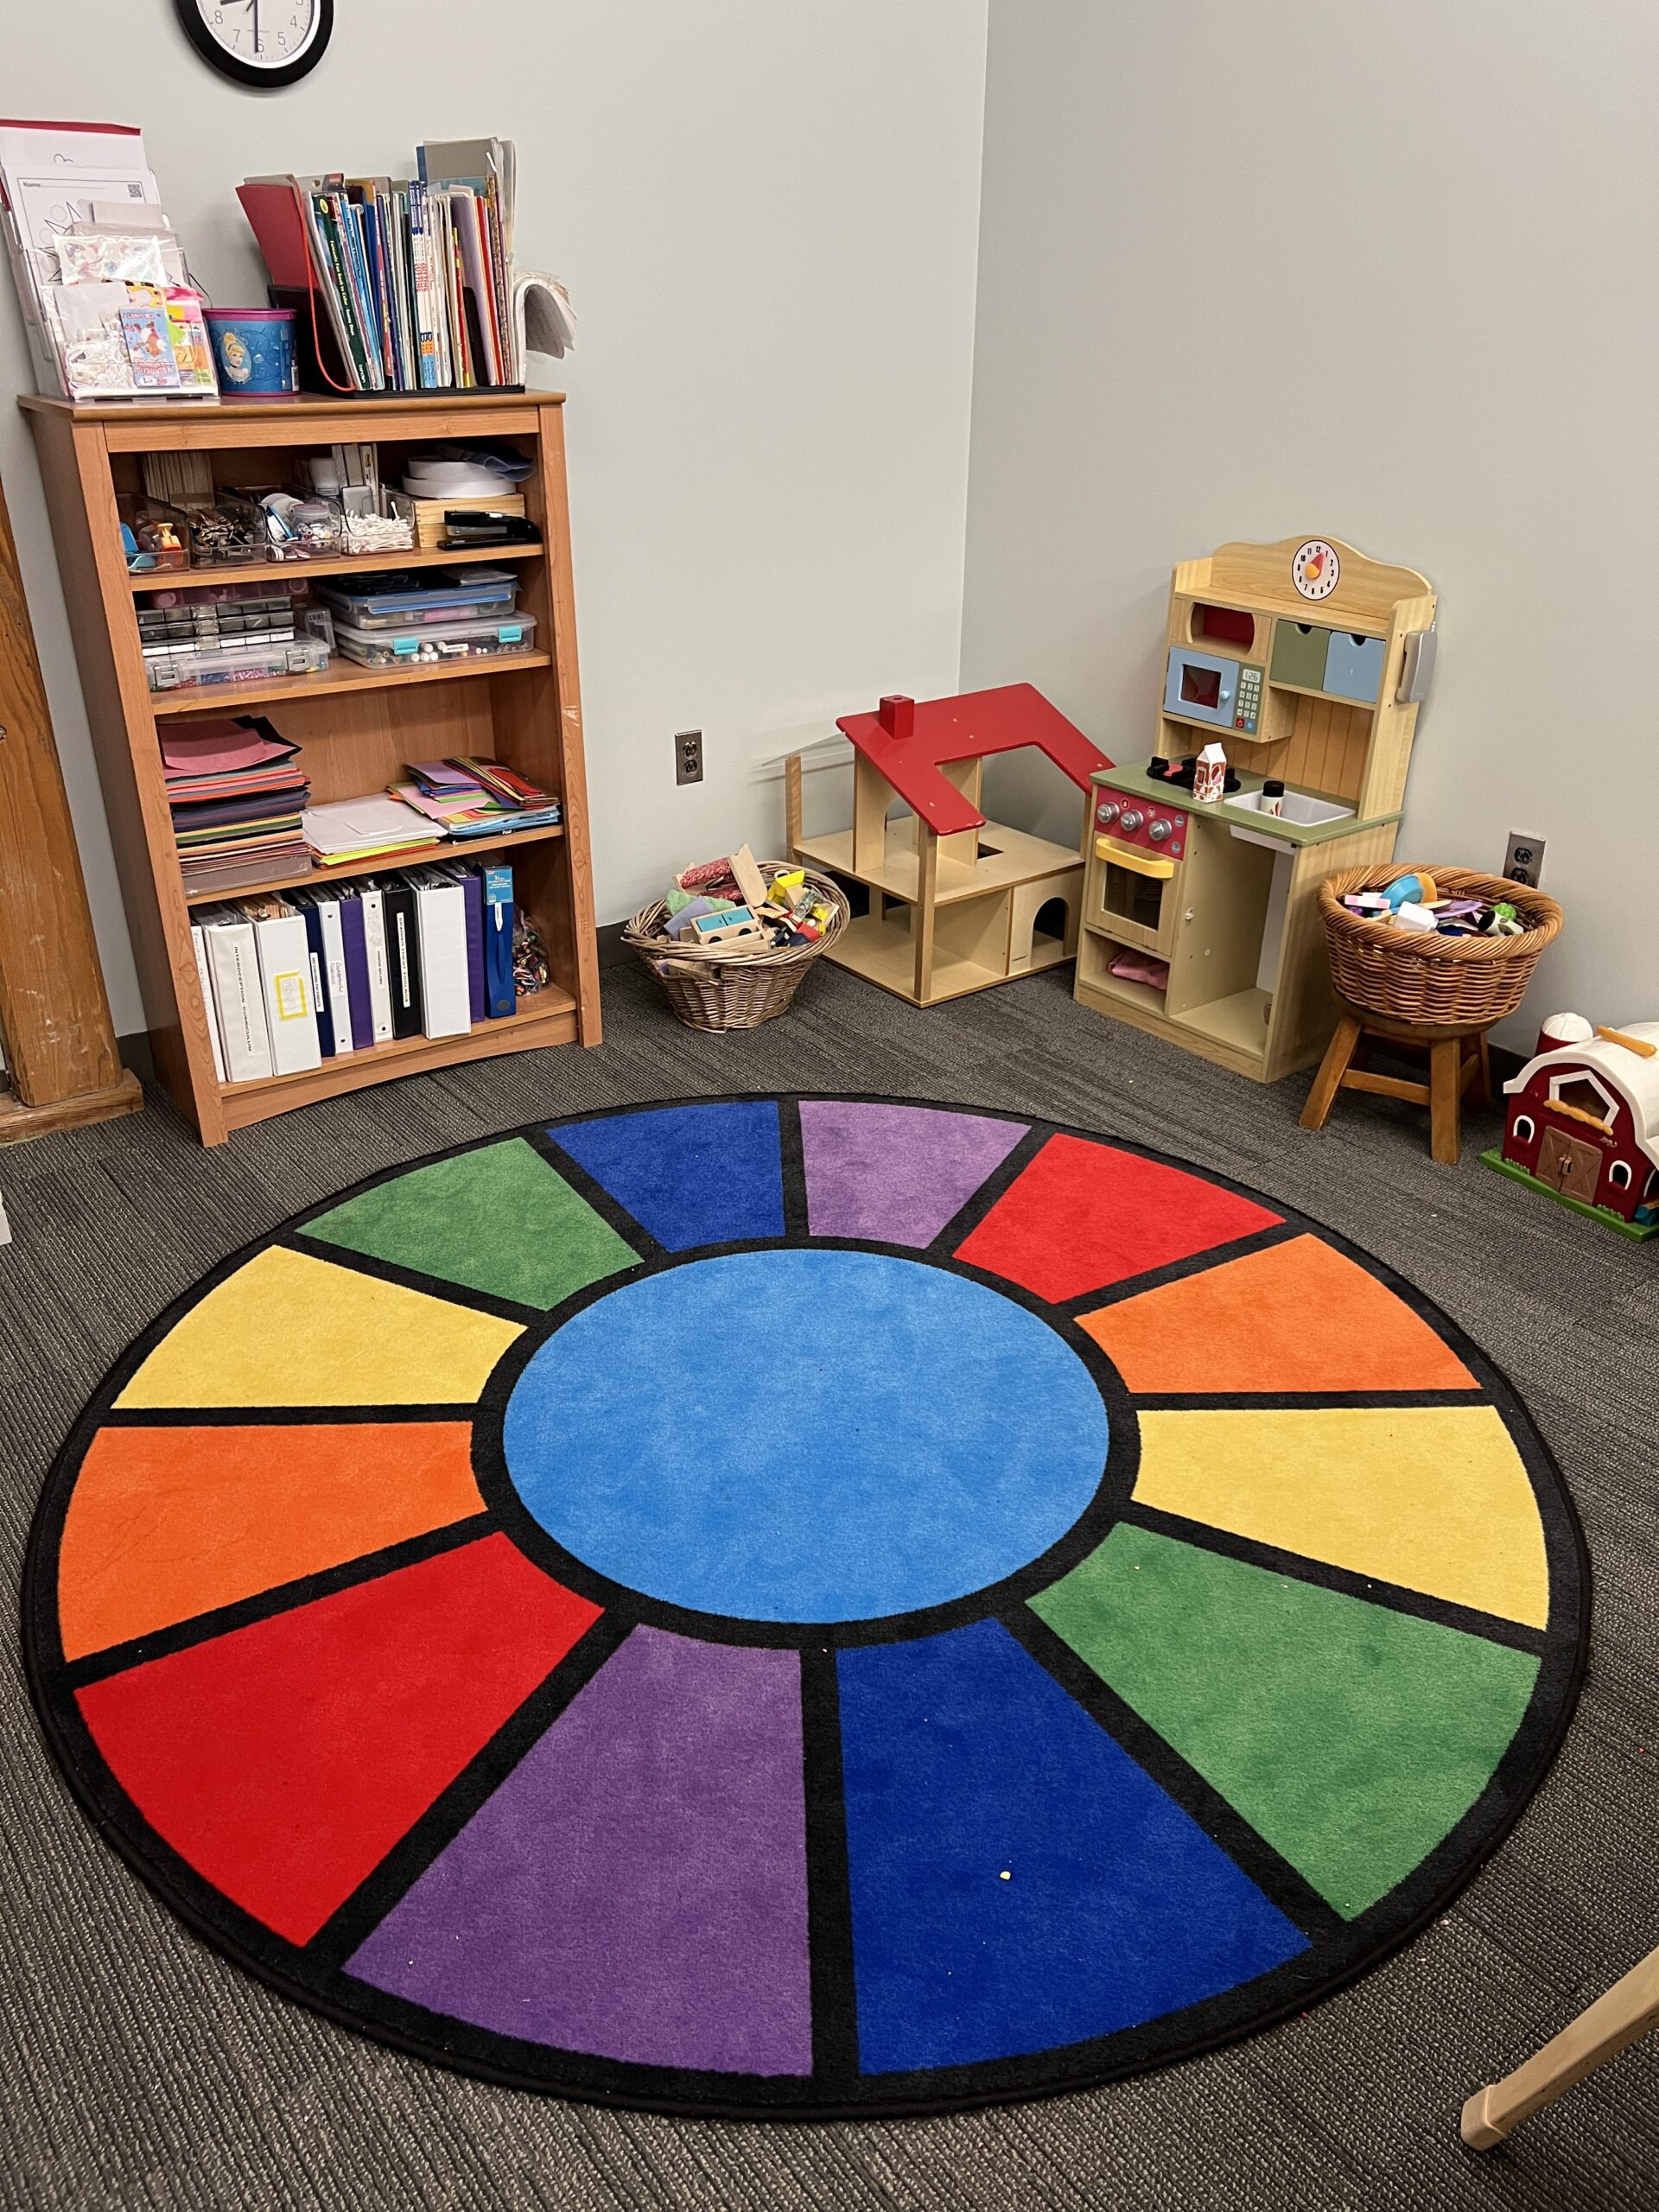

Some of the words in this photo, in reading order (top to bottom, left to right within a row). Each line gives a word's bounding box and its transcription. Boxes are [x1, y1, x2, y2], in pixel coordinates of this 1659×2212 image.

[214, 10, 223, 24] 8
[289, 15, 297, 28] 4
[232, 29, 240, 42] 7
[277, 32, 286, 46] 5
[258, 39, 264, 53] 6
[329, 240, 338, 263] Fantastic
[233, 946, 245, 1003] INTEROCEPTION
[241, 1006, 252, 1052] CURRICULUM
